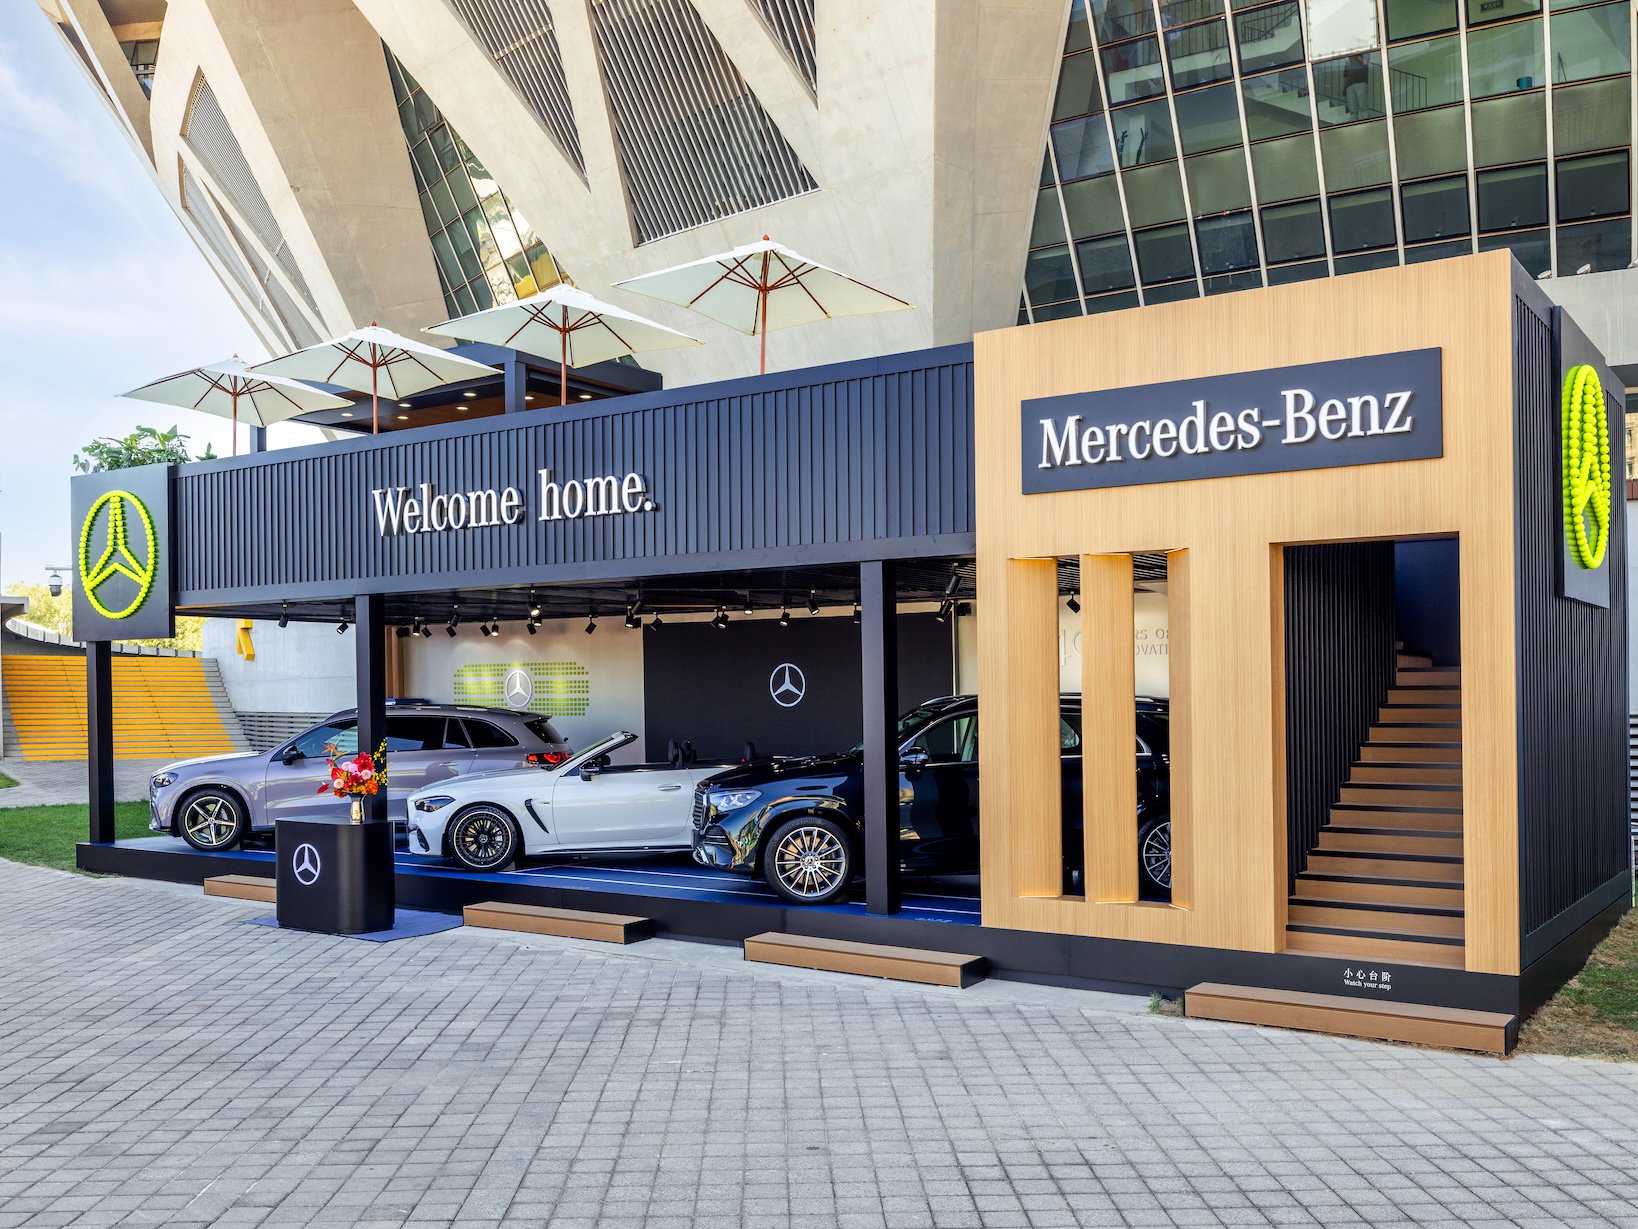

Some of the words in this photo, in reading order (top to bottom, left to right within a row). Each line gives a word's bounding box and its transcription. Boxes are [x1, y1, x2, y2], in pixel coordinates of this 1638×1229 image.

[1038, 388, 1414, 469] Mercedes-Benz
[372, 482, 522, 537] Welcome
[538, 468, 656, 522] home.
[1343, 968, 1392, 982] 小心台阶
[1343, 979, 1363, 987] Watch
[1363, 981, 1378, 989] your
[1378, 983, 1392, 991] step
